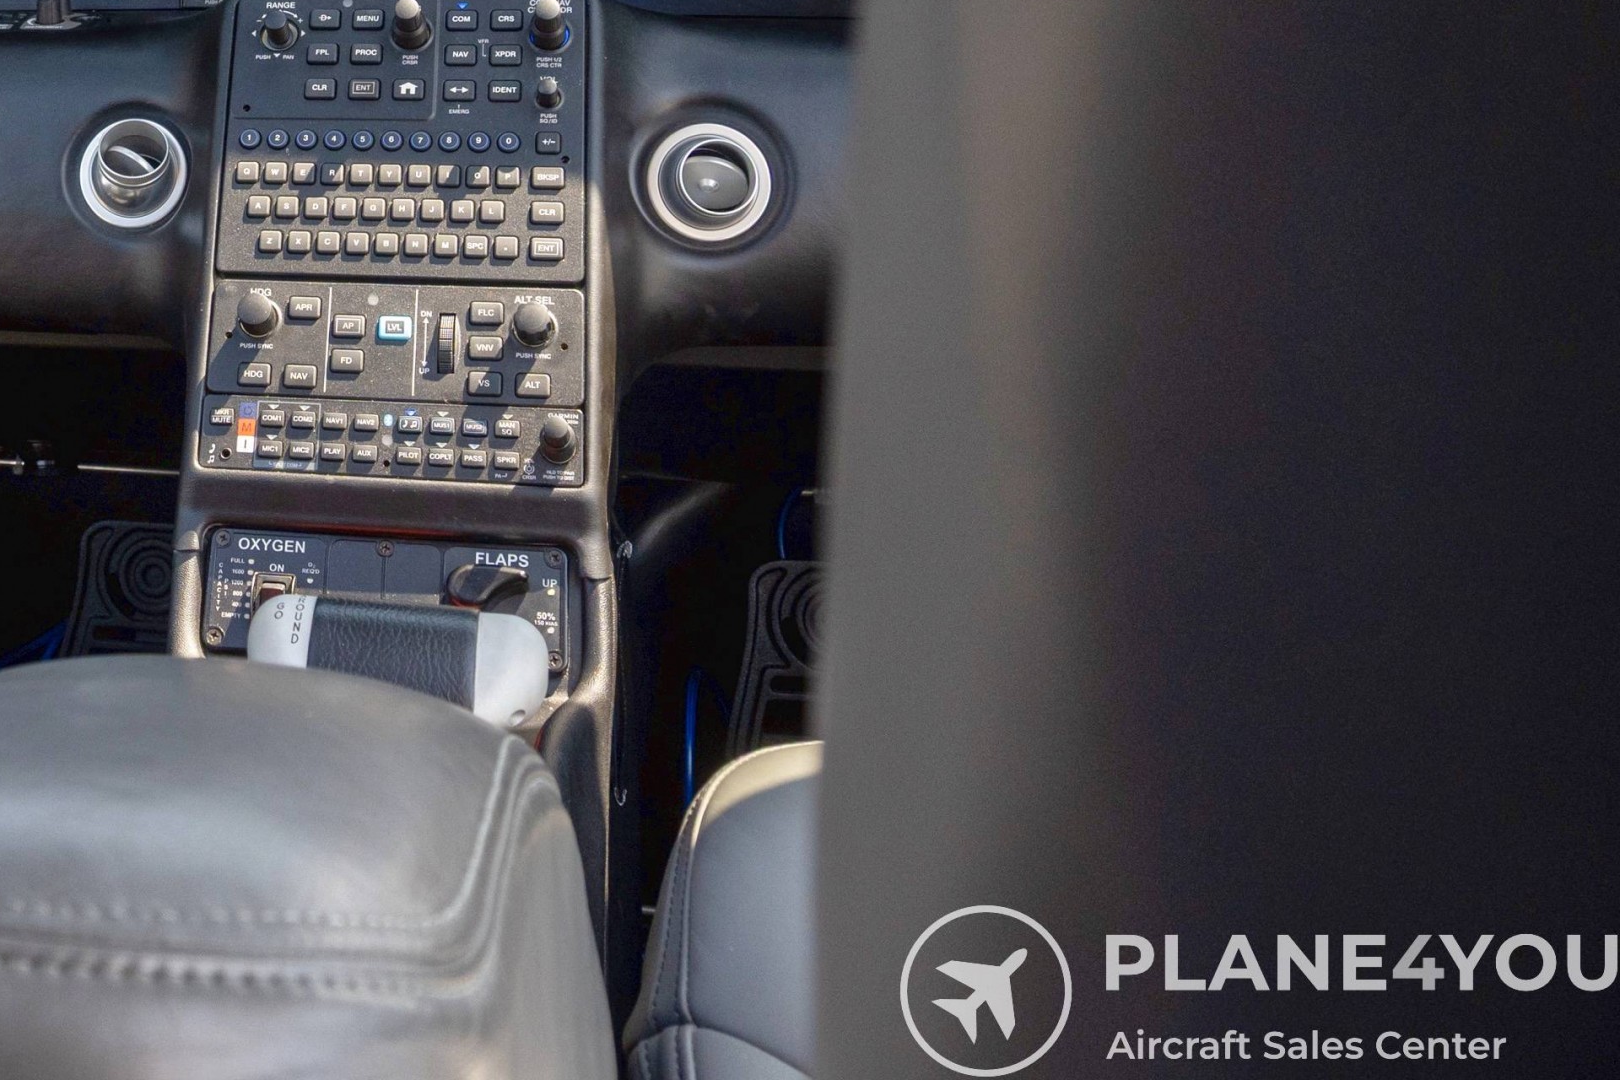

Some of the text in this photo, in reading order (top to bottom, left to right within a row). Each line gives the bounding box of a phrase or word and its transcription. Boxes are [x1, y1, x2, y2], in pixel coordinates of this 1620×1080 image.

[295, 303, 313, 311] APR
[477, 309, 495, 317] FLC
[340, 356, 352, 364] FD
[243, 370, 263, 378] HDG
[290, 372, 309, 380] NAV
[524, 381, 541, 389] ALT
[292, 446, 310, 454] MIC2
[324, 447, 340, 455] PLAY
[238, 537, 306, 553] OXYGEN
[475, 552, 529, 568] FLAPS
[269, 563, 285, 572] ON
[542, 578, 558, 588] UP
[536, 611, 556, 621] 50%
